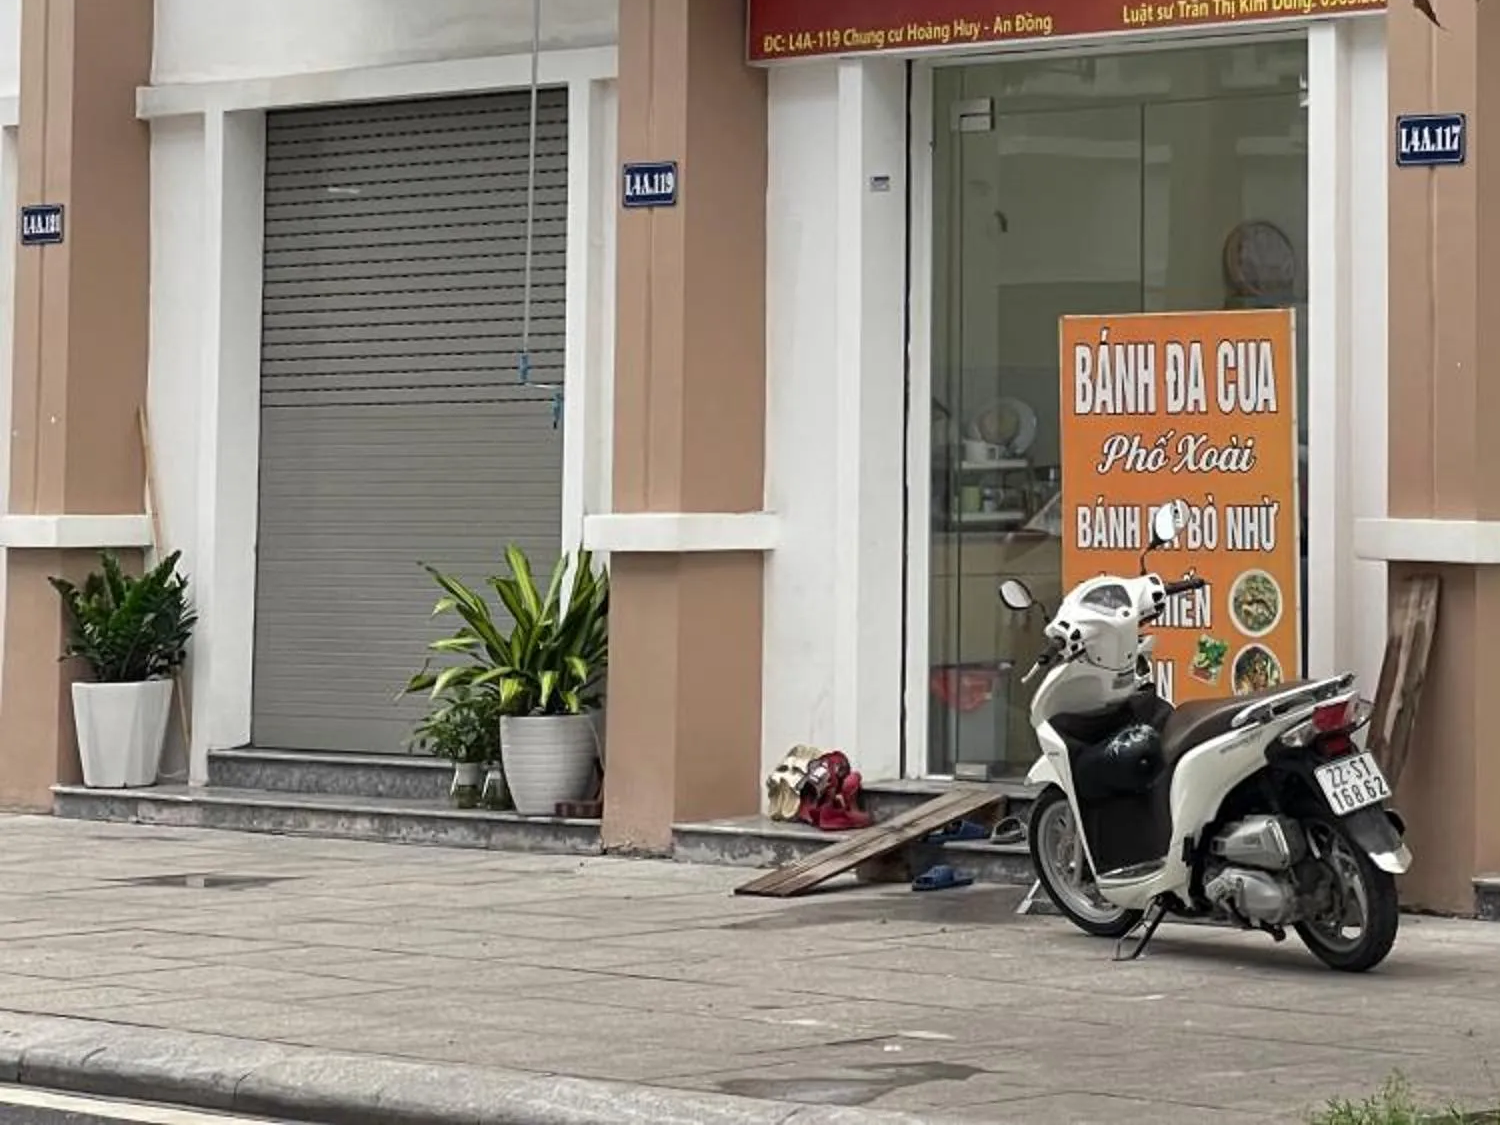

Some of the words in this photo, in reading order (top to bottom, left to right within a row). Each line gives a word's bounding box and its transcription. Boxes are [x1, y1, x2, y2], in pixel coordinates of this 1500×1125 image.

[789, 28, 840, 50] L4A-119
[843, 27, 885, 48] Chung
[953, 19, 980, 41] Huy
[993, 15, 1012, 34] An
[1123, 3, 1154, 26] Luật
[1074, 327, 1157, 415] BÁNH
[1165, 340, 1208, 415] ĐA
[1216, 339, 1278, 415] CUA
[1096, 429, 1176, 474] Phố
[1171, 431, 1257, 474] Xoài
[1076, 493, 1142, 551] BÁNH
[1186, 493, 1219, 552] BÒ
